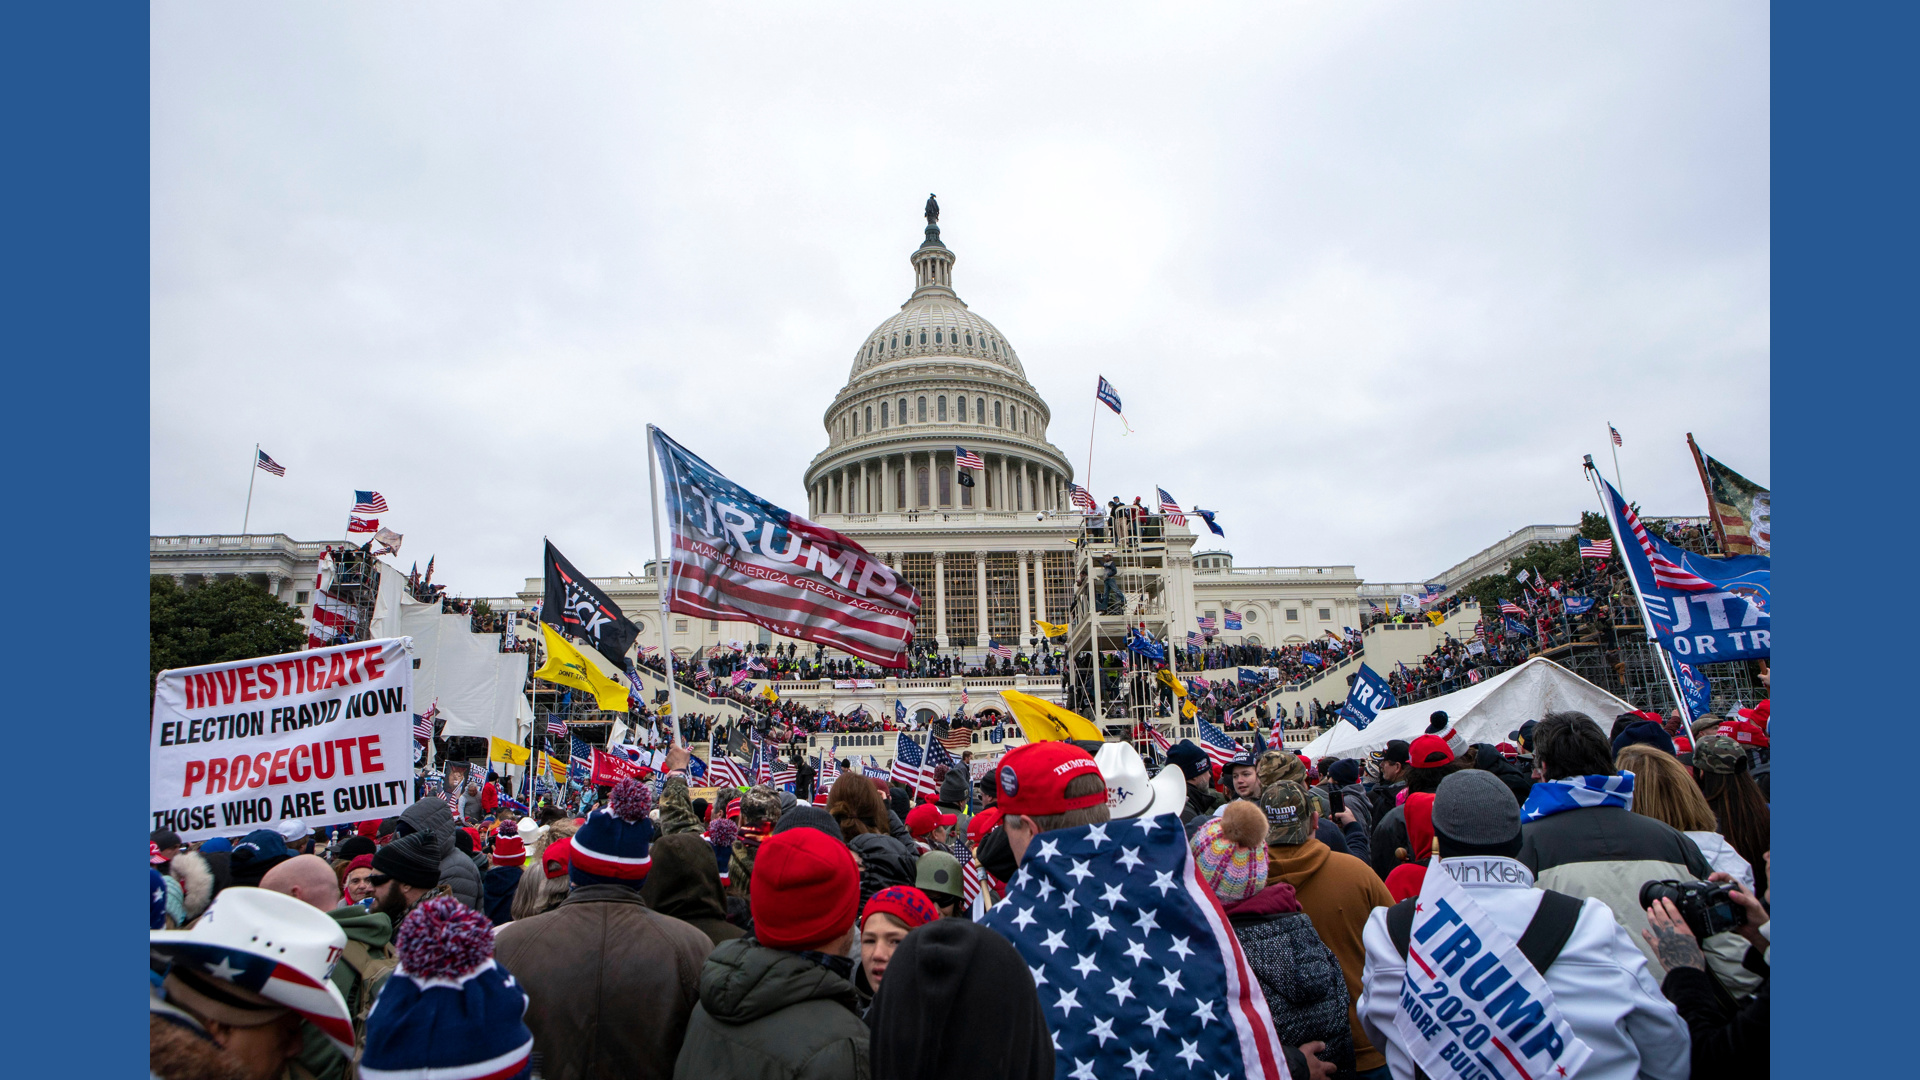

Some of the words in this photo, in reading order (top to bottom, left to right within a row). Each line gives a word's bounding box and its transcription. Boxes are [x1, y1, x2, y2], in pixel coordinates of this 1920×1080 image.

[691, 485, 897, 596] TRUMP
[691, 541, 732, 567] MAKING
[733, 561, 789, 583] AMERICA
[794, 578, 845, 602] GREAT
[848, 598, 899, 616] AGAIN!
[506, 612, 516, 648] TRUMP
[184, 645, 385, 710] INVESTIGATE
[160, 710, 264, 746] ELECTION
[271, 698, 342, 734] FRAUD
[345, 686, 407, 719] NOW.
[183, 735, 385, 798] PROSECUTE
[864, 769, 890, 780] TRUMP
[153, 804, 217, 832] THOSE
[221, 797, 273, 826] WHO
[280, 790, 327, 820] ARE
[333, 779, 407, 813] GUILTY
[1265, 804, 1297, 815] Trump
[1444, 862, 1481, 882] lvin
[1484, 862, 1525, 884] Klein
[1413, 898, 1564, 1062] TRUMP
[1401, 1001, 1442, 1042] MORE
[1419, 981, 1491, 1051] 2020
